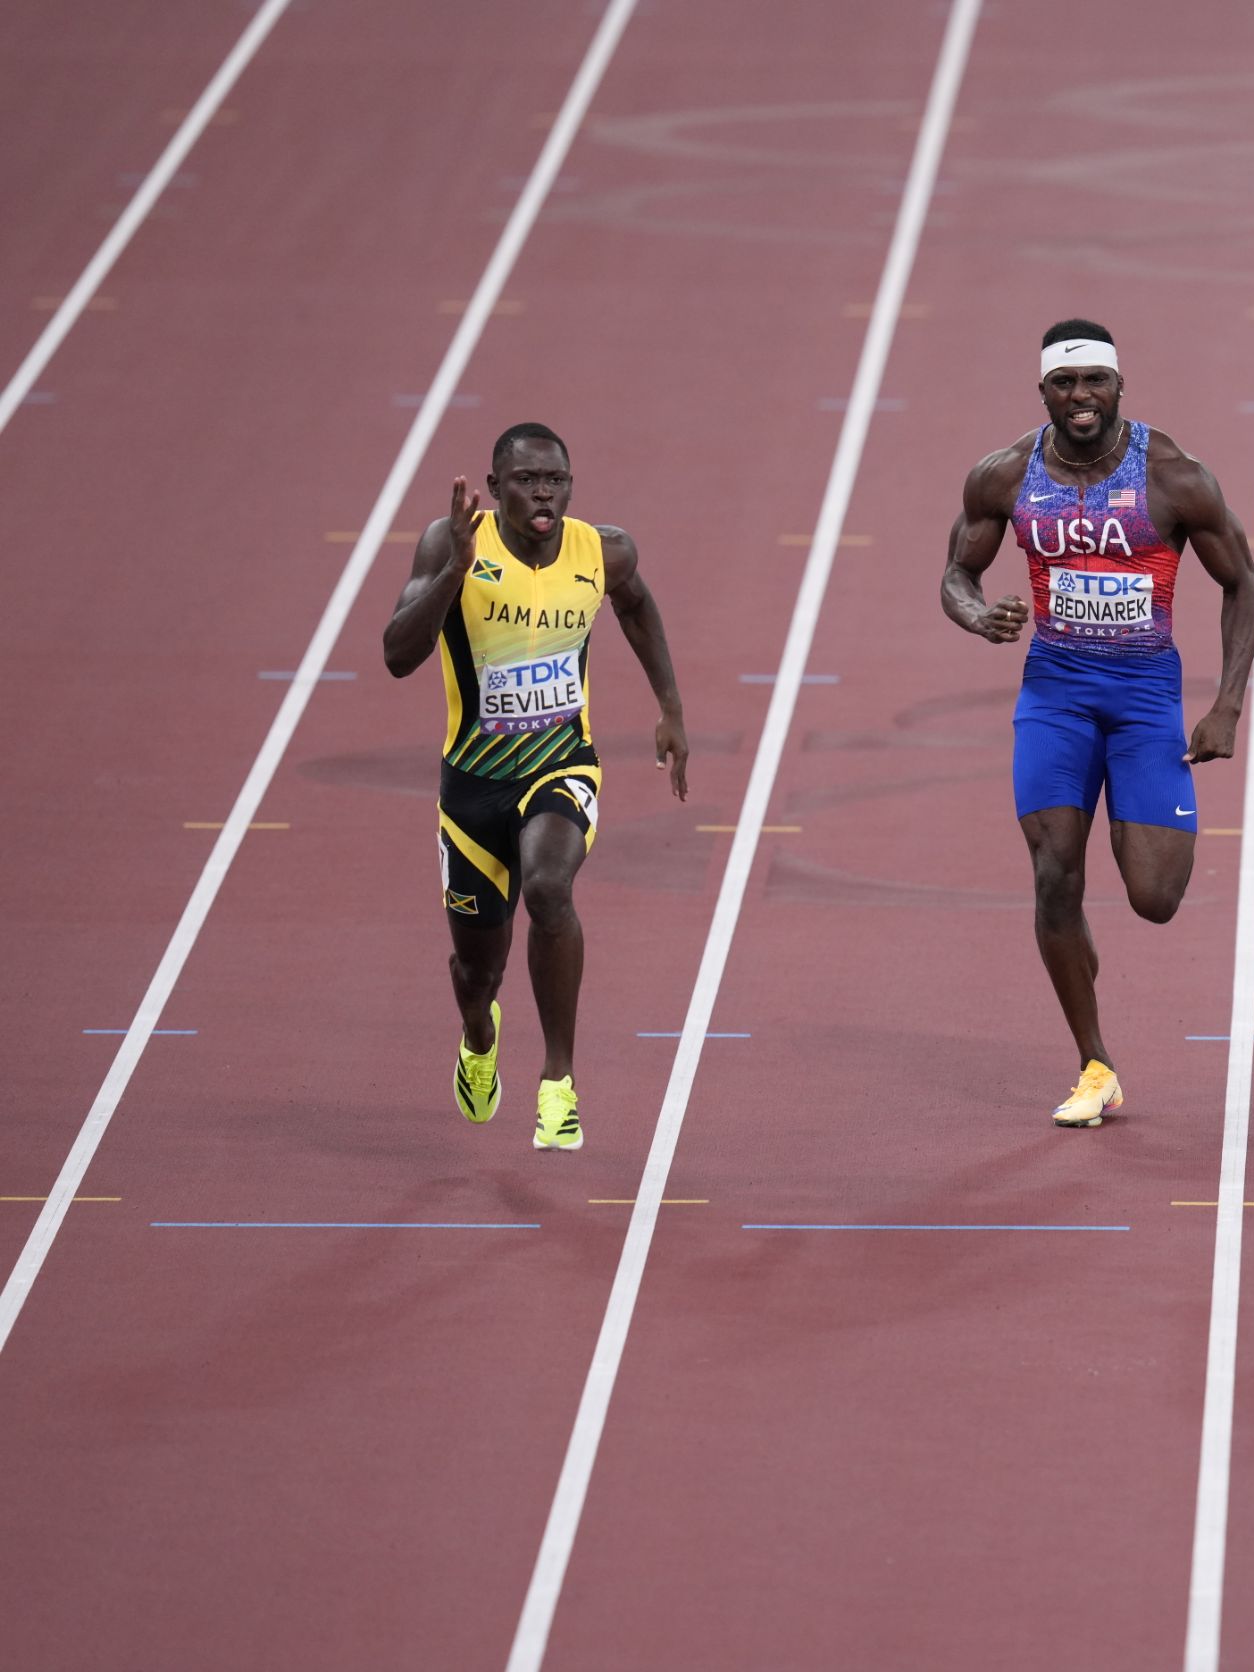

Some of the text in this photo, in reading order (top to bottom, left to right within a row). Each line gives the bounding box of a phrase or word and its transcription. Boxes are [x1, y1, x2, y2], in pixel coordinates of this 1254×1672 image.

[1031, 518, 1132, 557] USA
[1075, 574, 1145, 597] TDK
[484, 601, 586, 629] JAMAICA
[1054, 595, 1147, 622] BEDNAREK
[507, 656, 574, 687] TDK
[485, 682, 578, 714] SEVILLE
